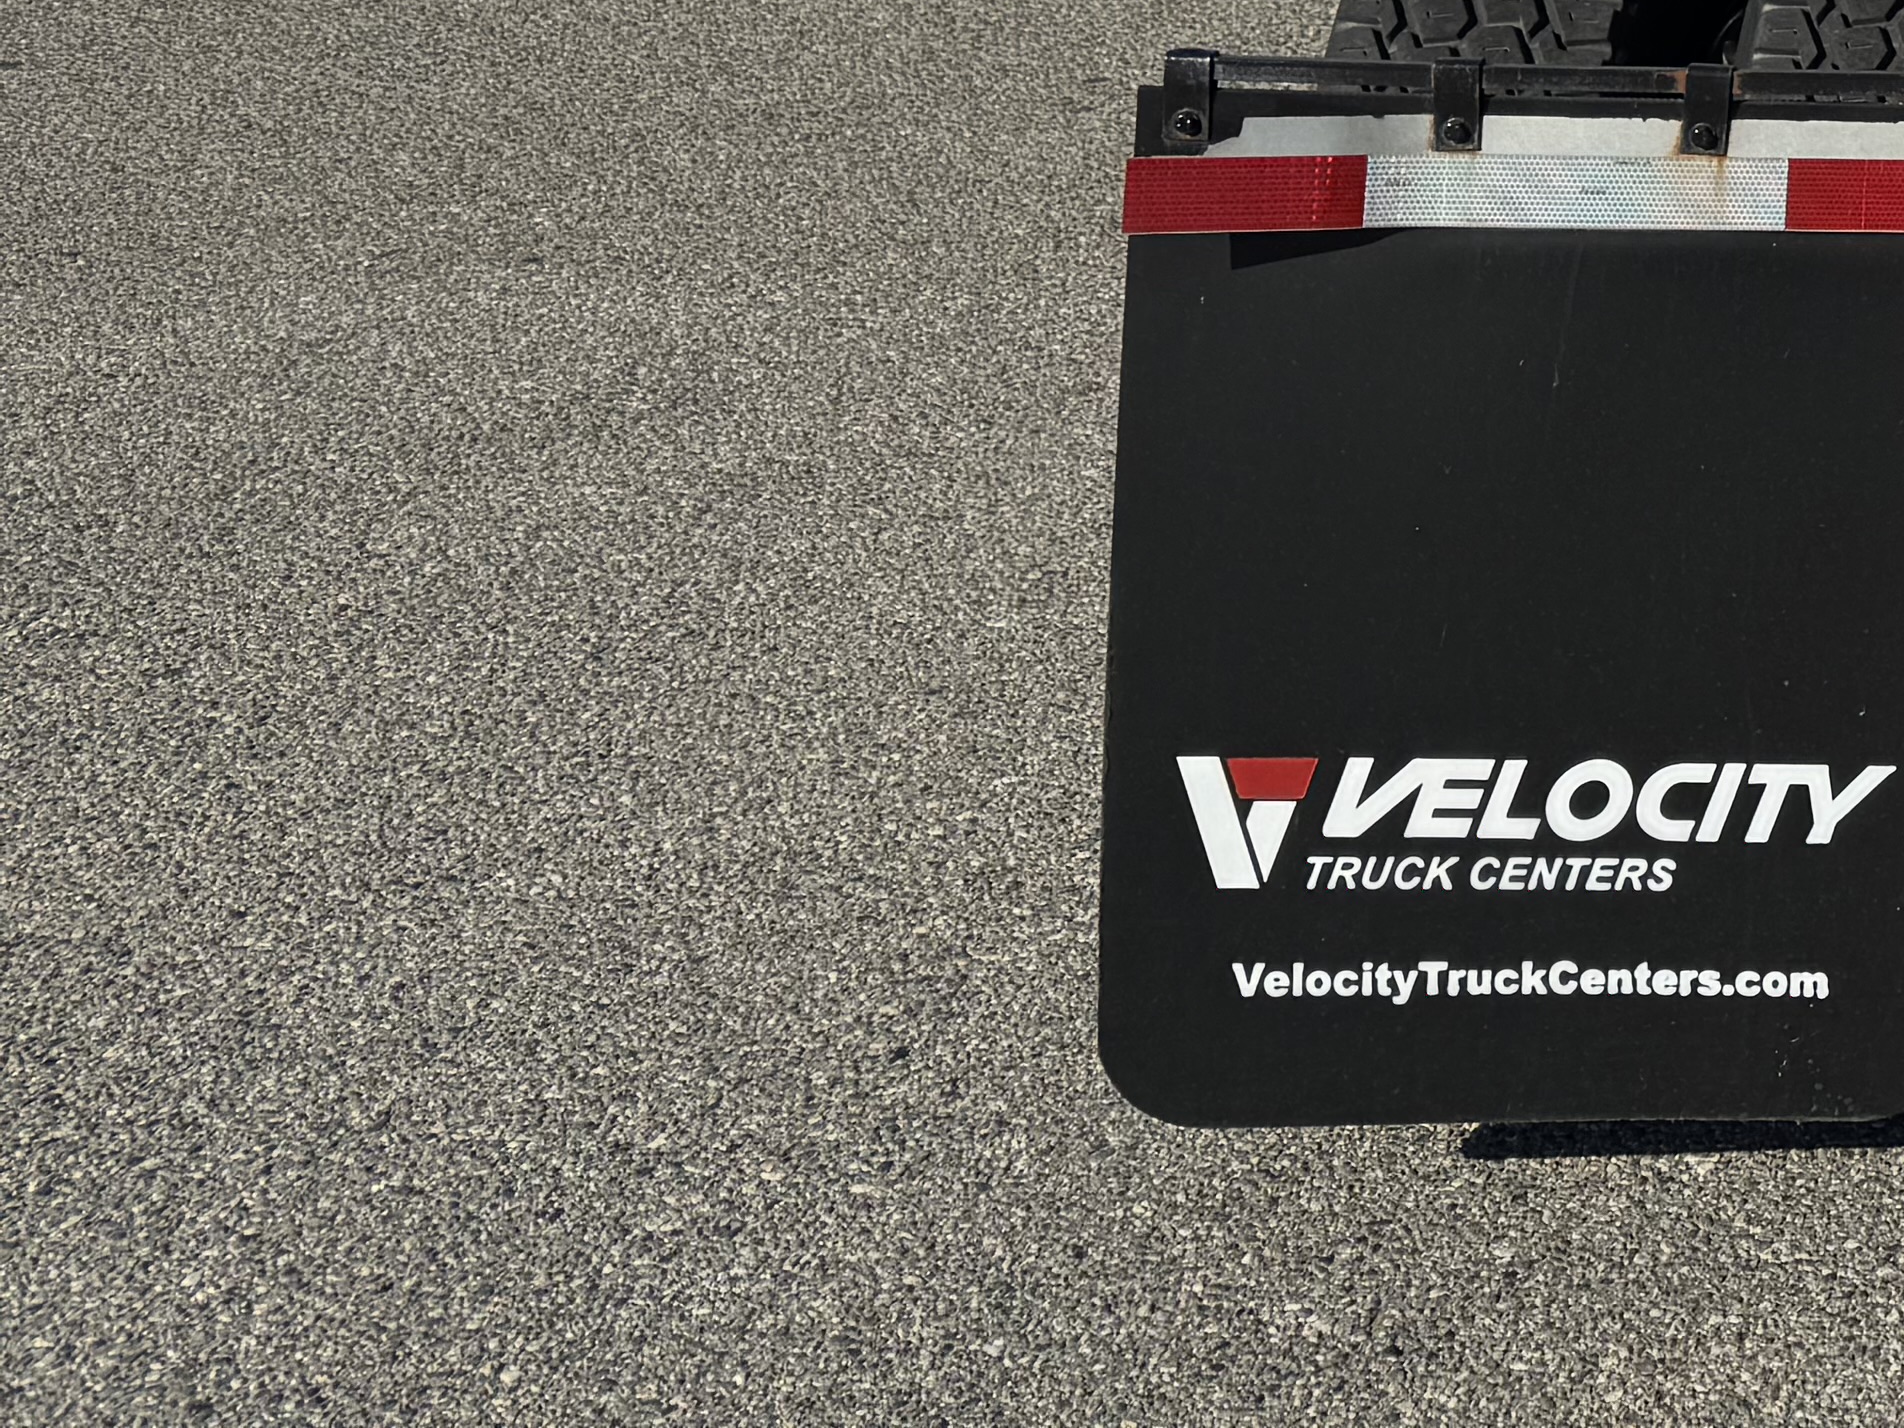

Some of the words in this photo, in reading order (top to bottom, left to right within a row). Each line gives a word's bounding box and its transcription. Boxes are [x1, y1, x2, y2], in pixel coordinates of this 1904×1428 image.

[1321, 756, 1898, 845] VELOCITY
[1304, 854, 1462, 892] TRUCK
[1468, 855, 1678, 893] CENTERS
[1230, 959, 1831, 1006] VelocityTruckCenters.com
